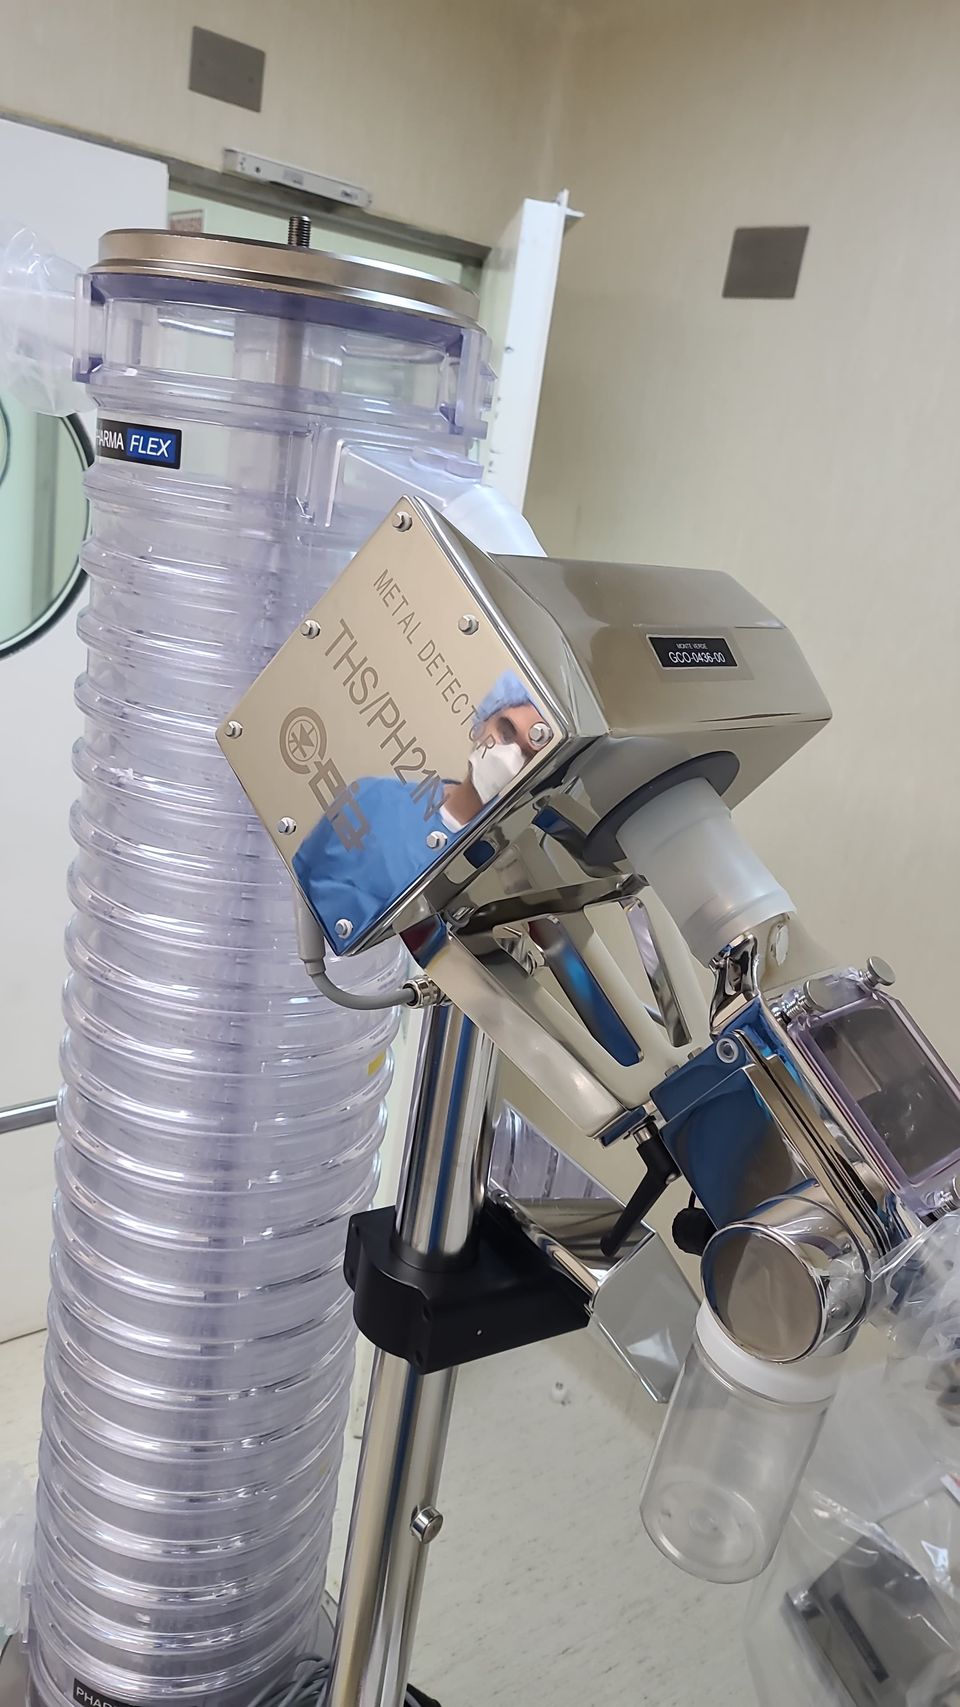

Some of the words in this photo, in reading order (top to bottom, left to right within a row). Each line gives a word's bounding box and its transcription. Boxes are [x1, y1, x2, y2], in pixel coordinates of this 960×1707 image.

[129, 434, 172, 458] FLEX
[373, 569, 422, 644] METAL
[417, 639, 496, 760] DETECTOR
[668, 651, 725, 663] GCO-0436-00
[324, 618, 450, 823] THS/PH21N
